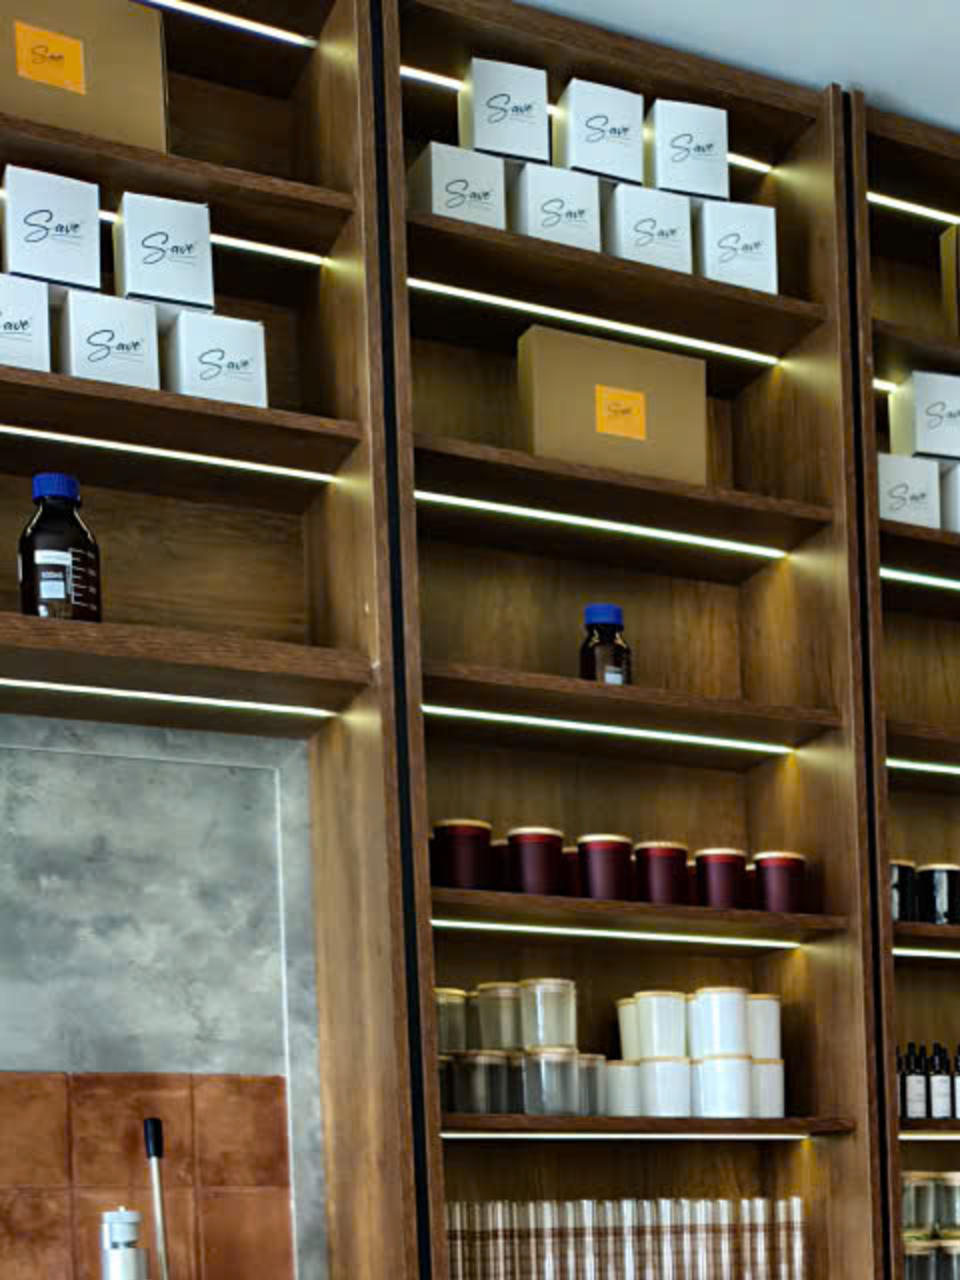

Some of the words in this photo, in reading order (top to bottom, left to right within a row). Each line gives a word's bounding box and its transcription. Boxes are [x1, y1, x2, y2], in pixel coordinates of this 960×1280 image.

[486, 93, 534, 124] Save
[585, 115, 632, 143] Save
[670, 134, 714, 163] Save
[445, 179, 493, 208] Save
[24, 209, 82, 243] Save
[541, 199, 587, 227] Save
[634, 218, 681, 247] Save
[142, 232, 195, 265] Save
[717, 233, 763, 263] Save
[0, 312, 33, 333] ave
[87, 330, 144, 362] Save
[199, 349, 253, 381] Save
